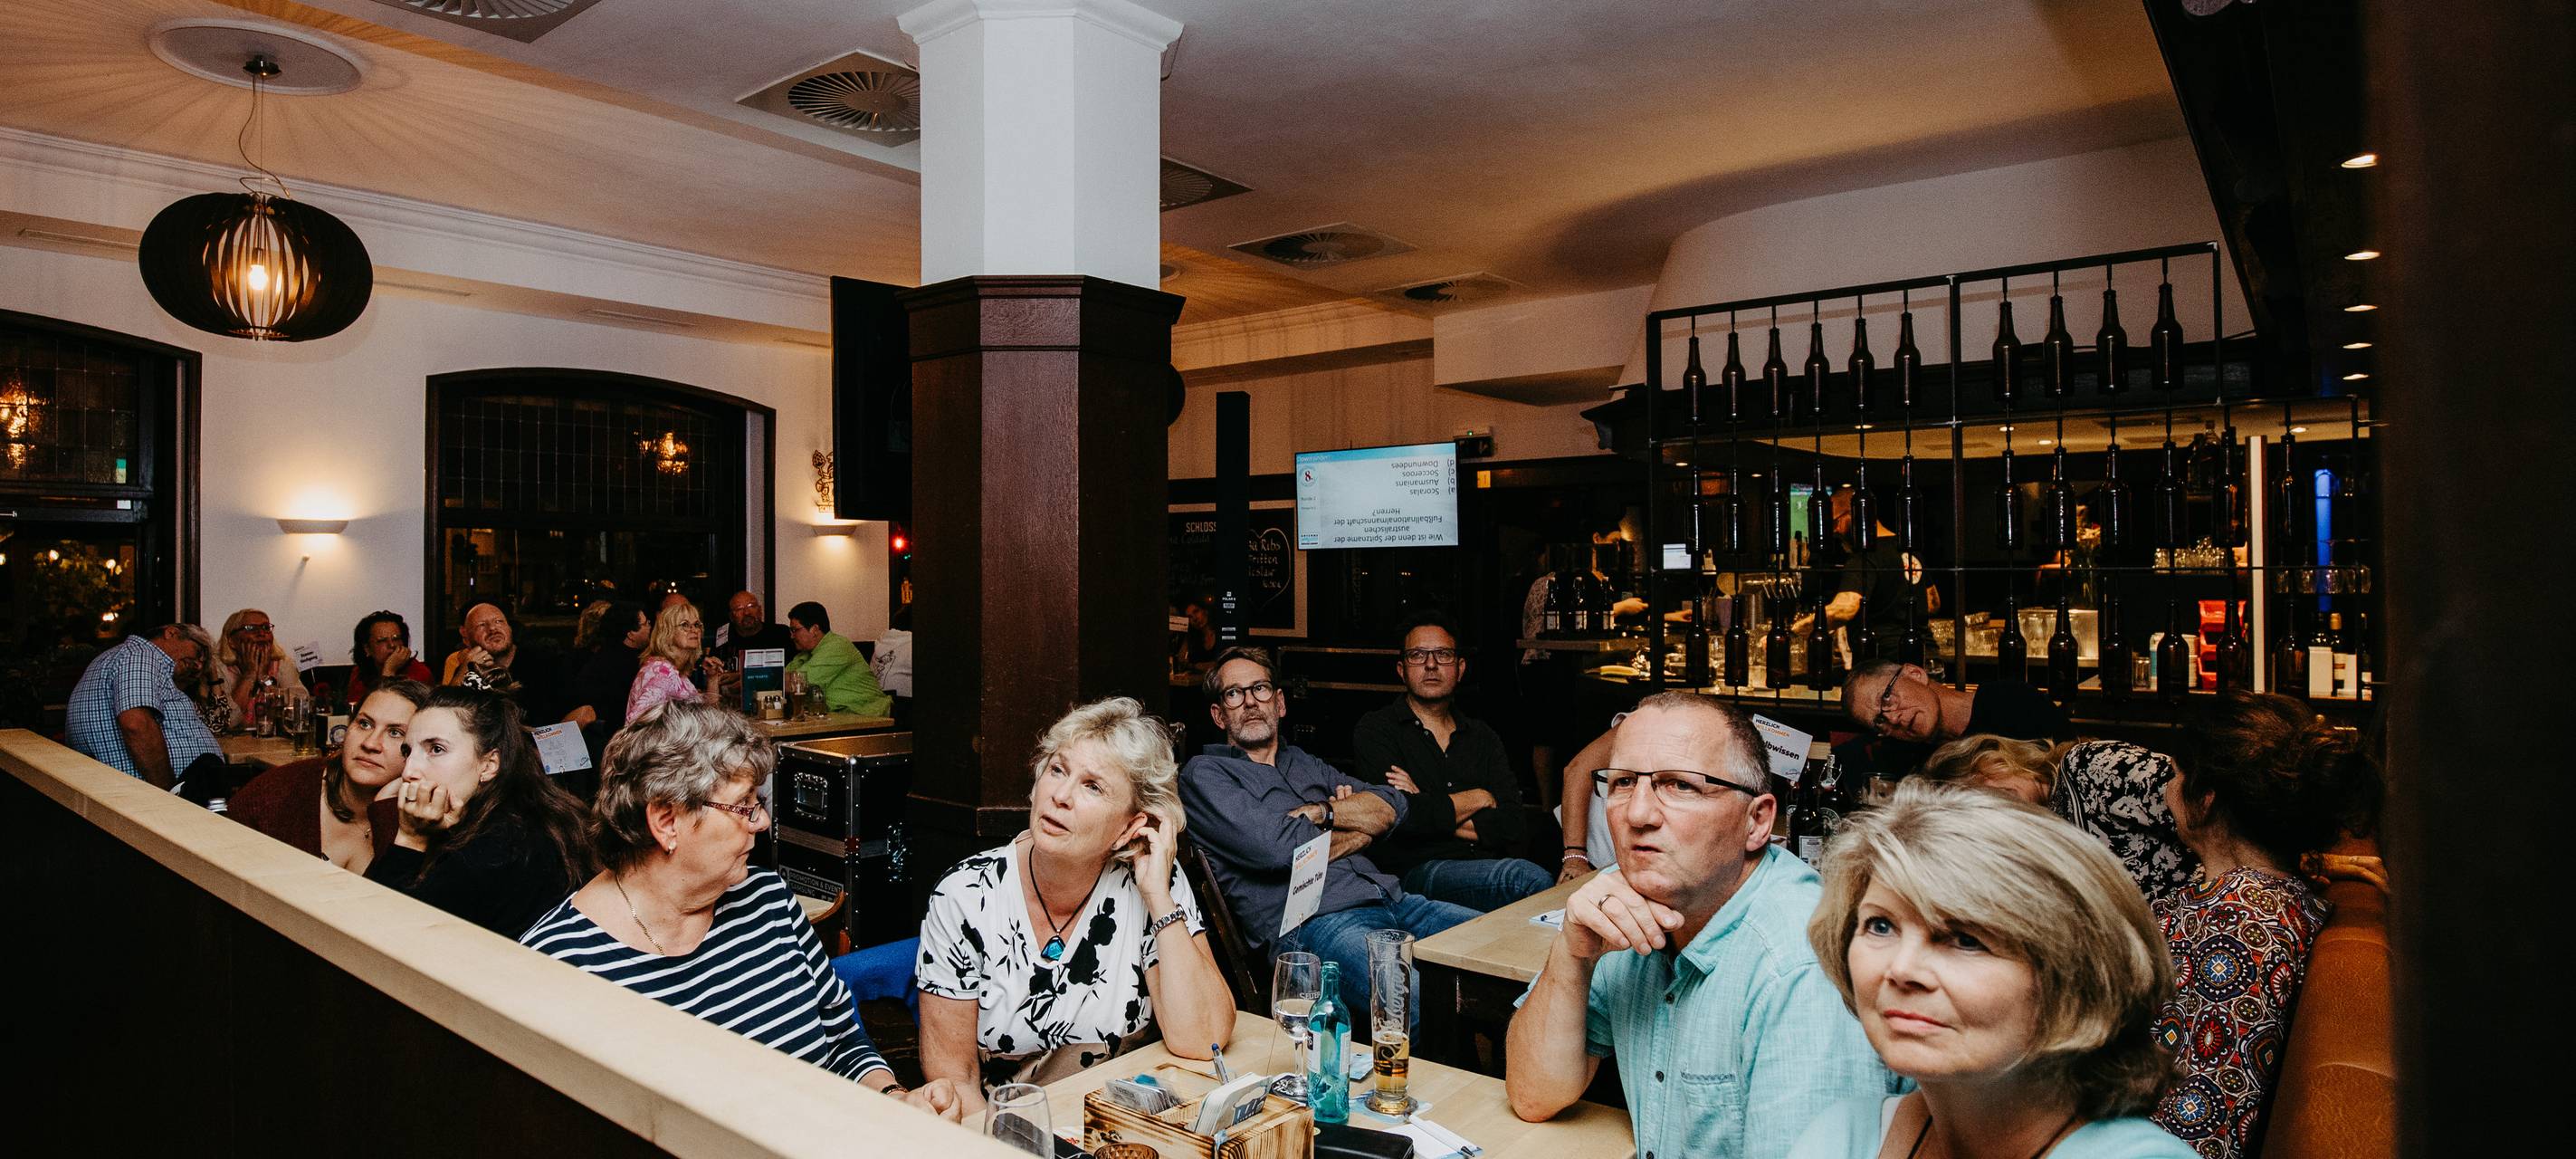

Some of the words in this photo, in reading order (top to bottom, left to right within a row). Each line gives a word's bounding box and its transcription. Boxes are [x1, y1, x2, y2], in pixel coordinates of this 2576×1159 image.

[1391, 460, 1438, 469] Downundees
[1402, 469, 1439, 477] Socceroos
[1448, 467, 1455, 476] c)
[1395, 478, 1439, 487] Ausmanians
[1448, 477, 1455, 485] b)
[1409, 488, 1439, 496] Scoralas
[1448, 486, 1455, 495] a)
[1371, 508, 1400, 516] Herren?
[1333, 518, 1345, 526] der
[1346, 515, 1442, 525] Fußballnationalmannschaft
[1364, 525, 1409, 533] australischen
[1347, 534, 1382, 543] Spitzname
[1398, 533, 1416, 541] denn
[1428, 533, 1443, 541] Wie
[1755, 718, 1780, 730] HERZLICH
[1755, 723, 1790, 737] WILLKOMMEN
[1764, 741, 1800, 760] lbwissen
[789, 870, 820, 887] PROMOTION
